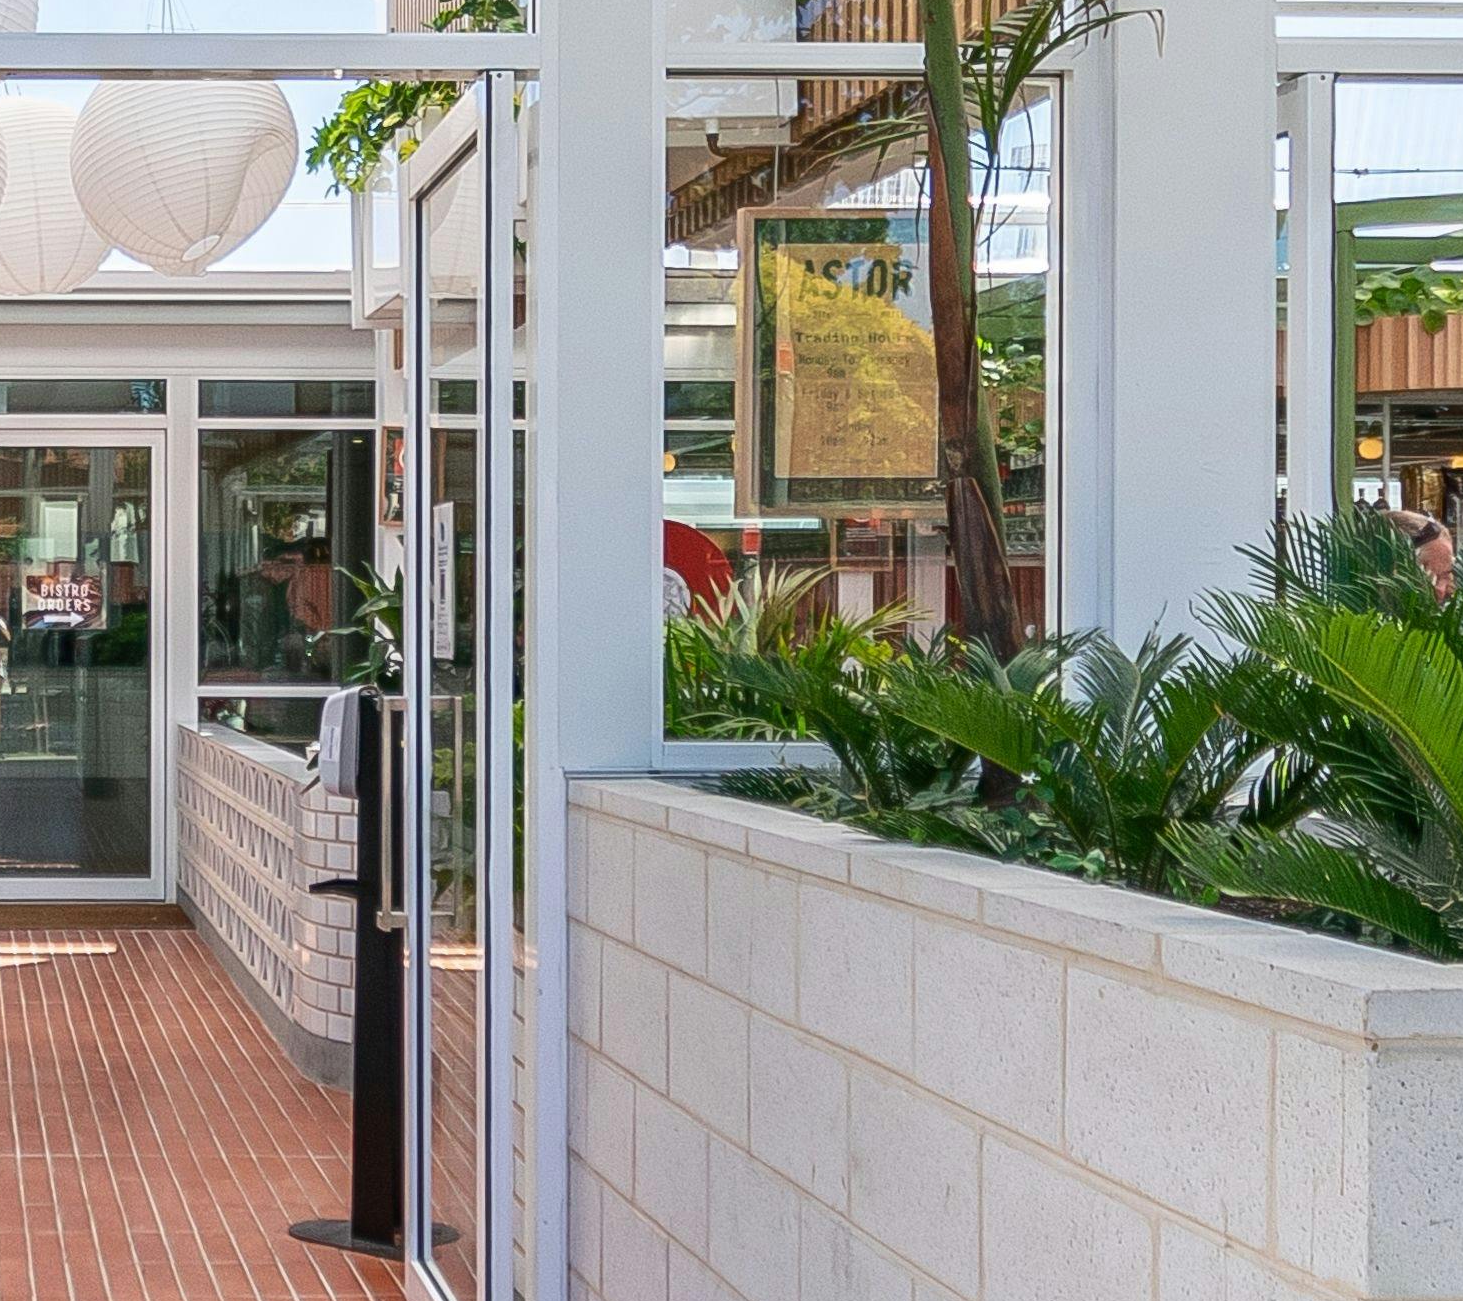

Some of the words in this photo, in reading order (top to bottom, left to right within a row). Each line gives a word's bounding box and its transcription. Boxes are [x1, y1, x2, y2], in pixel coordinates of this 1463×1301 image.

[798, 258, 915, 300] ASTOR
[795, 331, 859, 346] Trading
[40, 583, 90, 597] BISTRO
[37, 598, 92, 611] ORDERS
